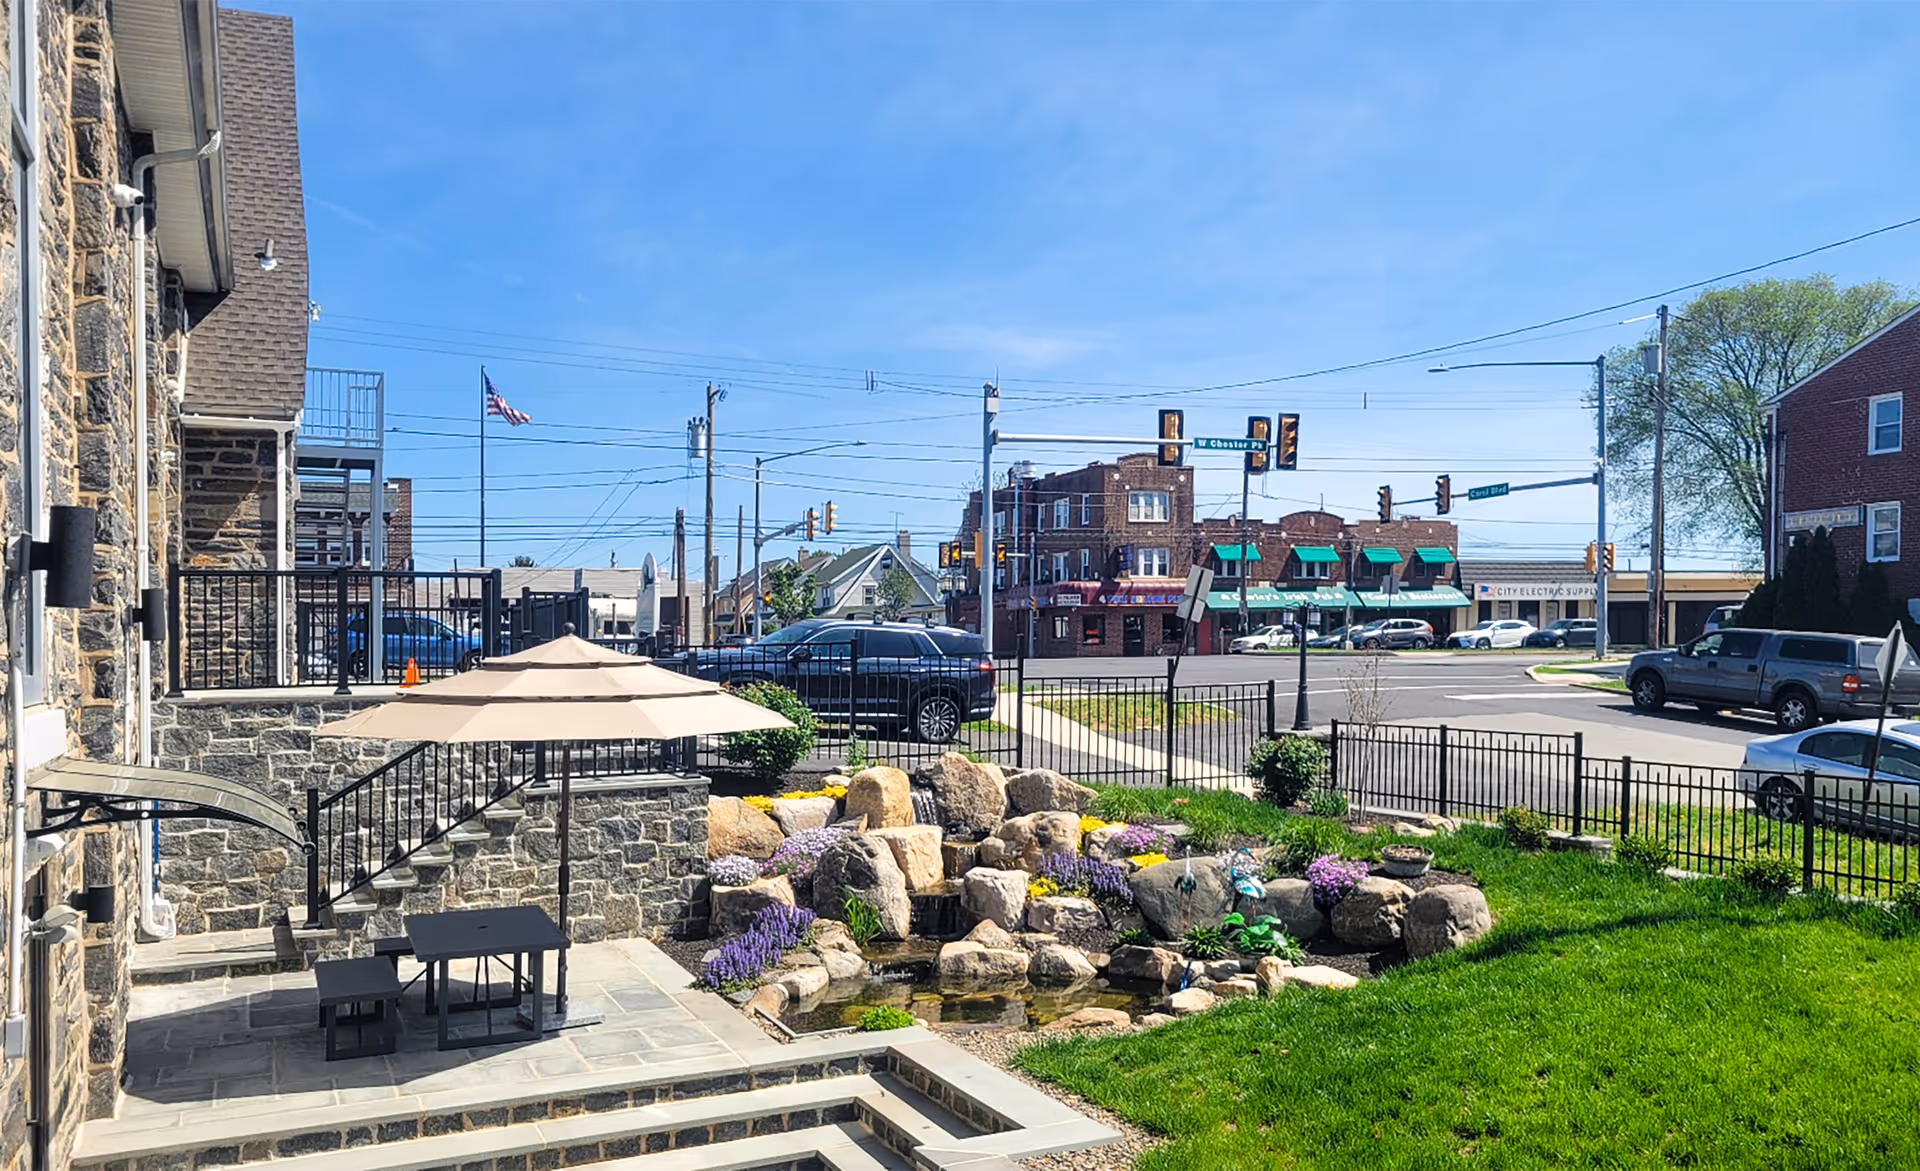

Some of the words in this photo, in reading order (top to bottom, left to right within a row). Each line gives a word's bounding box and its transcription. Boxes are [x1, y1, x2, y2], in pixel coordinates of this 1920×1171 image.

[1198, 439, 1207, 447] W
[1210, 439, 1248, 449] Chester
[1251, 441, 1264, 449] Pk
[1497, 587, 1518, 596] CITY
[1519, 587, 1564, 596] ELECTRIC
[1231, 592, 1280, 602] Cwley's
